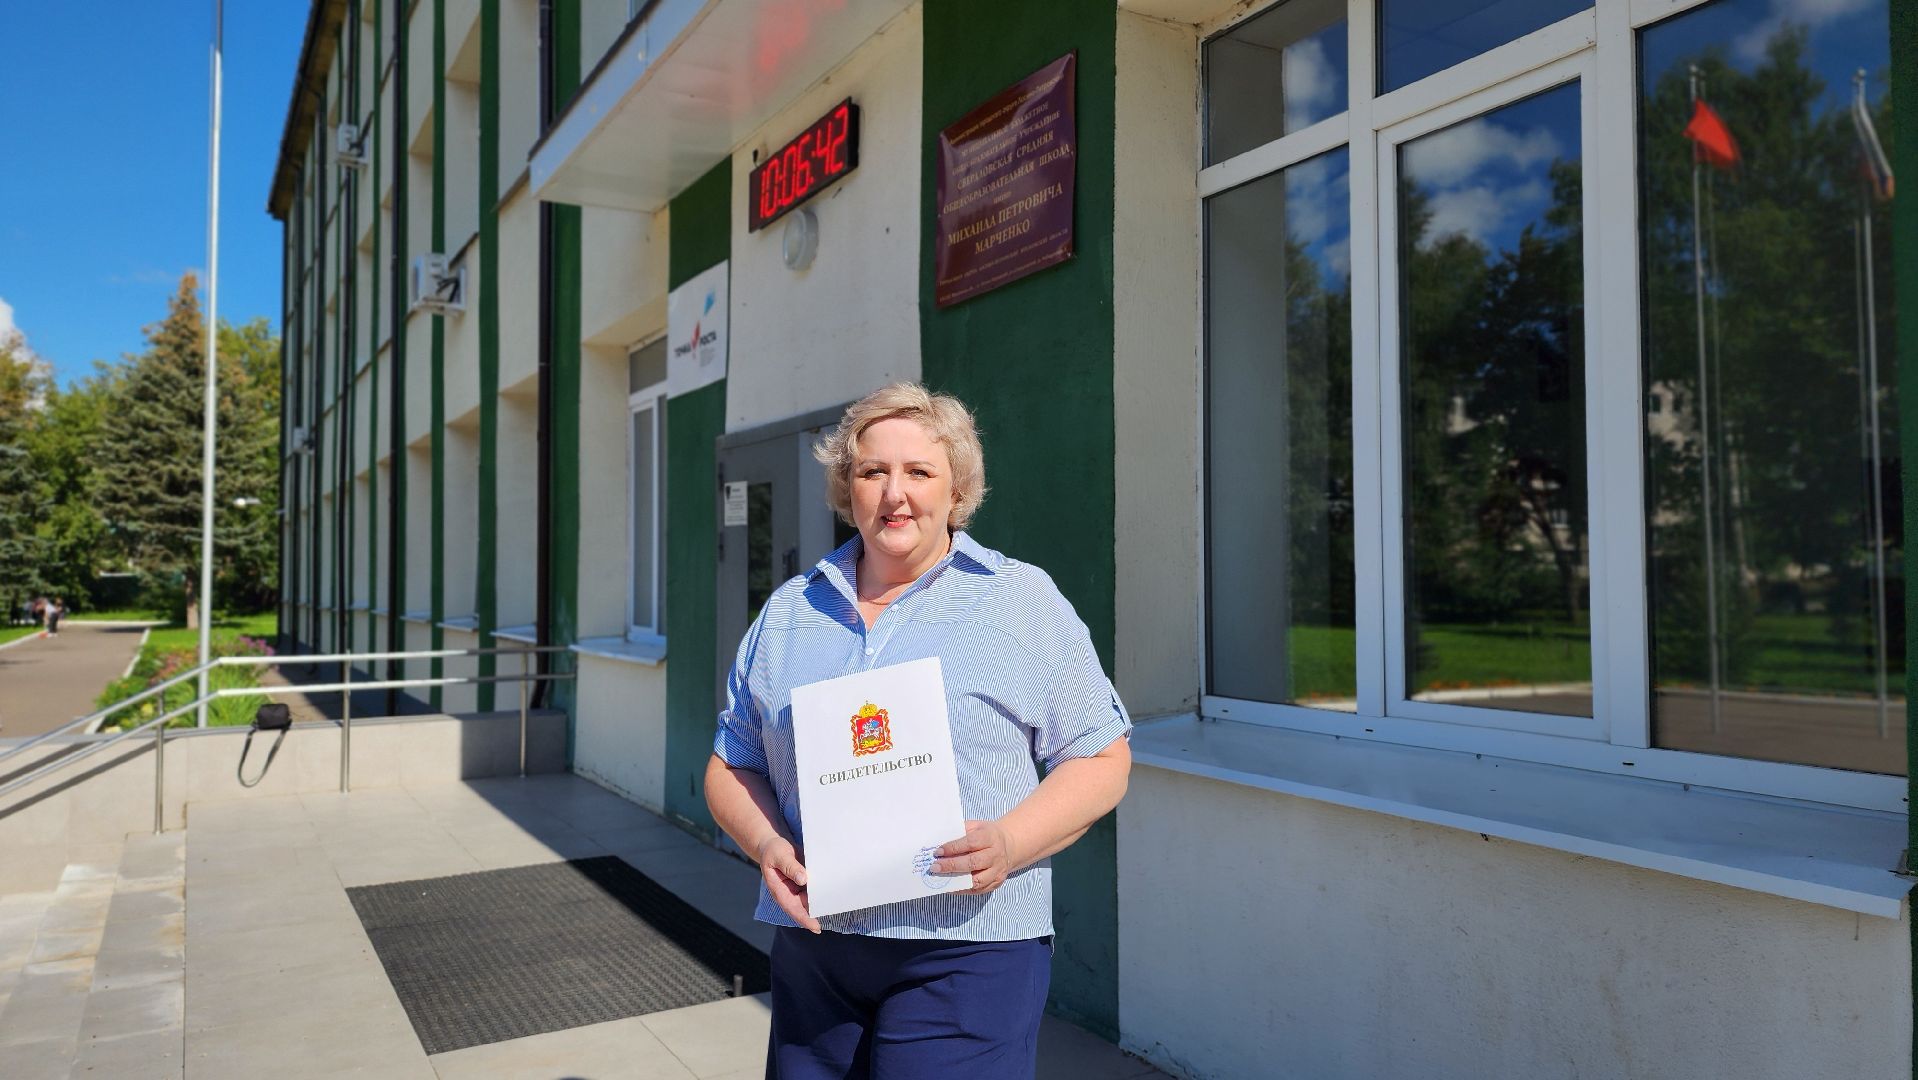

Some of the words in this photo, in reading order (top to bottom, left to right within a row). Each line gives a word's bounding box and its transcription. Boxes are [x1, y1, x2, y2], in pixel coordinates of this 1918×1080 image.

[1016, 129, 1053, 158] СРЕДНЯЯ
[1039, 142, 1069, 167] ШКОЛА
[947, 212, 996, 247] МИХАИЛА
[998, 180, 1063, 223] ПЕТРОВИЧА
[975, 218, 1029, 254] МАРЧЕНКО
[819, 753, 933, 785] СВИДЕТЕЛЬСТВО
